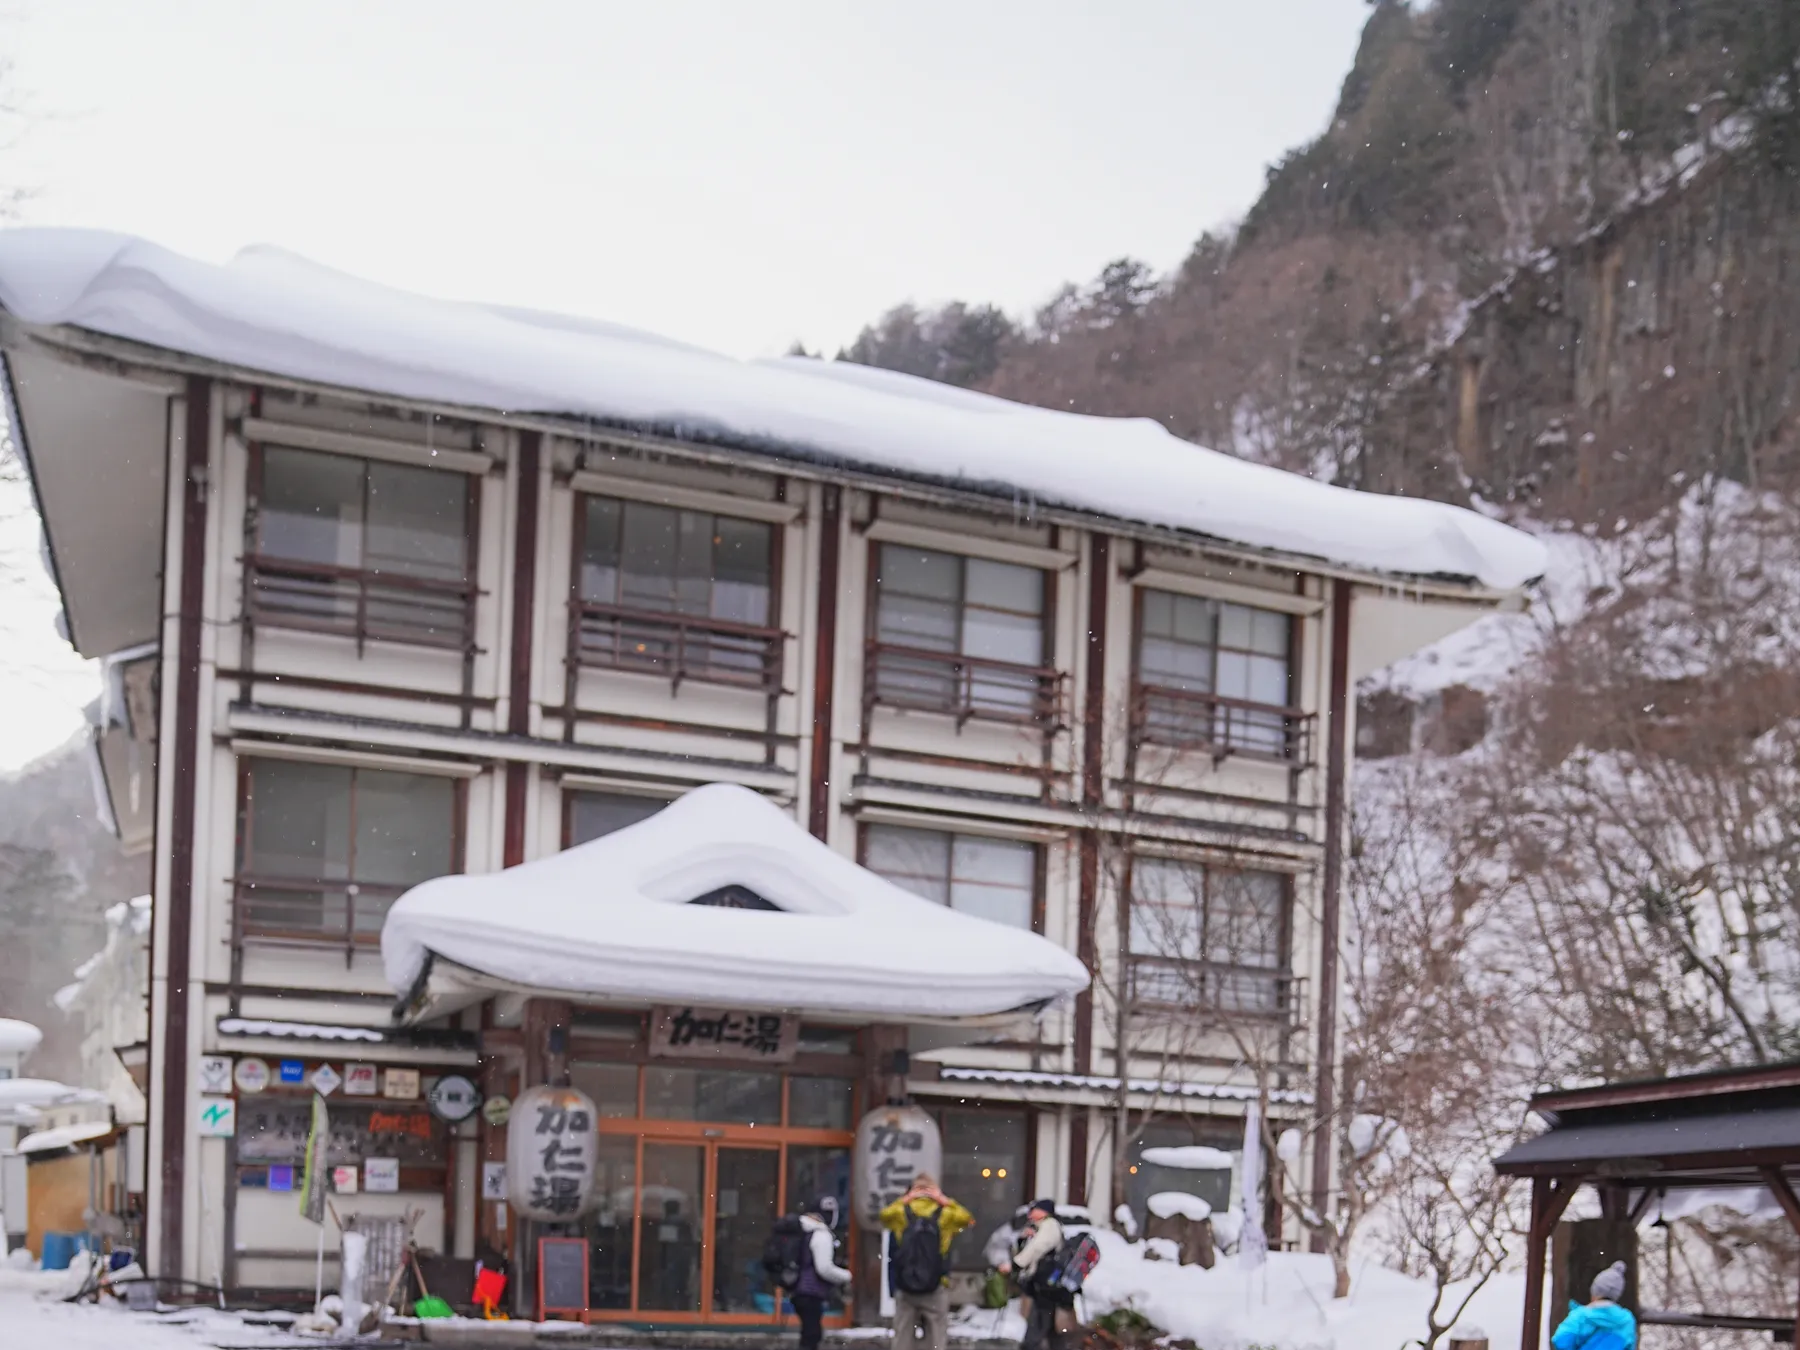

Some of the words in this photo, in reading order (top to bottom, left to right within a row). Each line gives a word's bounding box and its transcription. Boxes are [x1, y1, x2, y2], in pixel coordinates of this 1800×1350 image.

[669, 1006, 781, 1055] 加仁湯
[529, 1106, 590, 1215] 加仁湯
